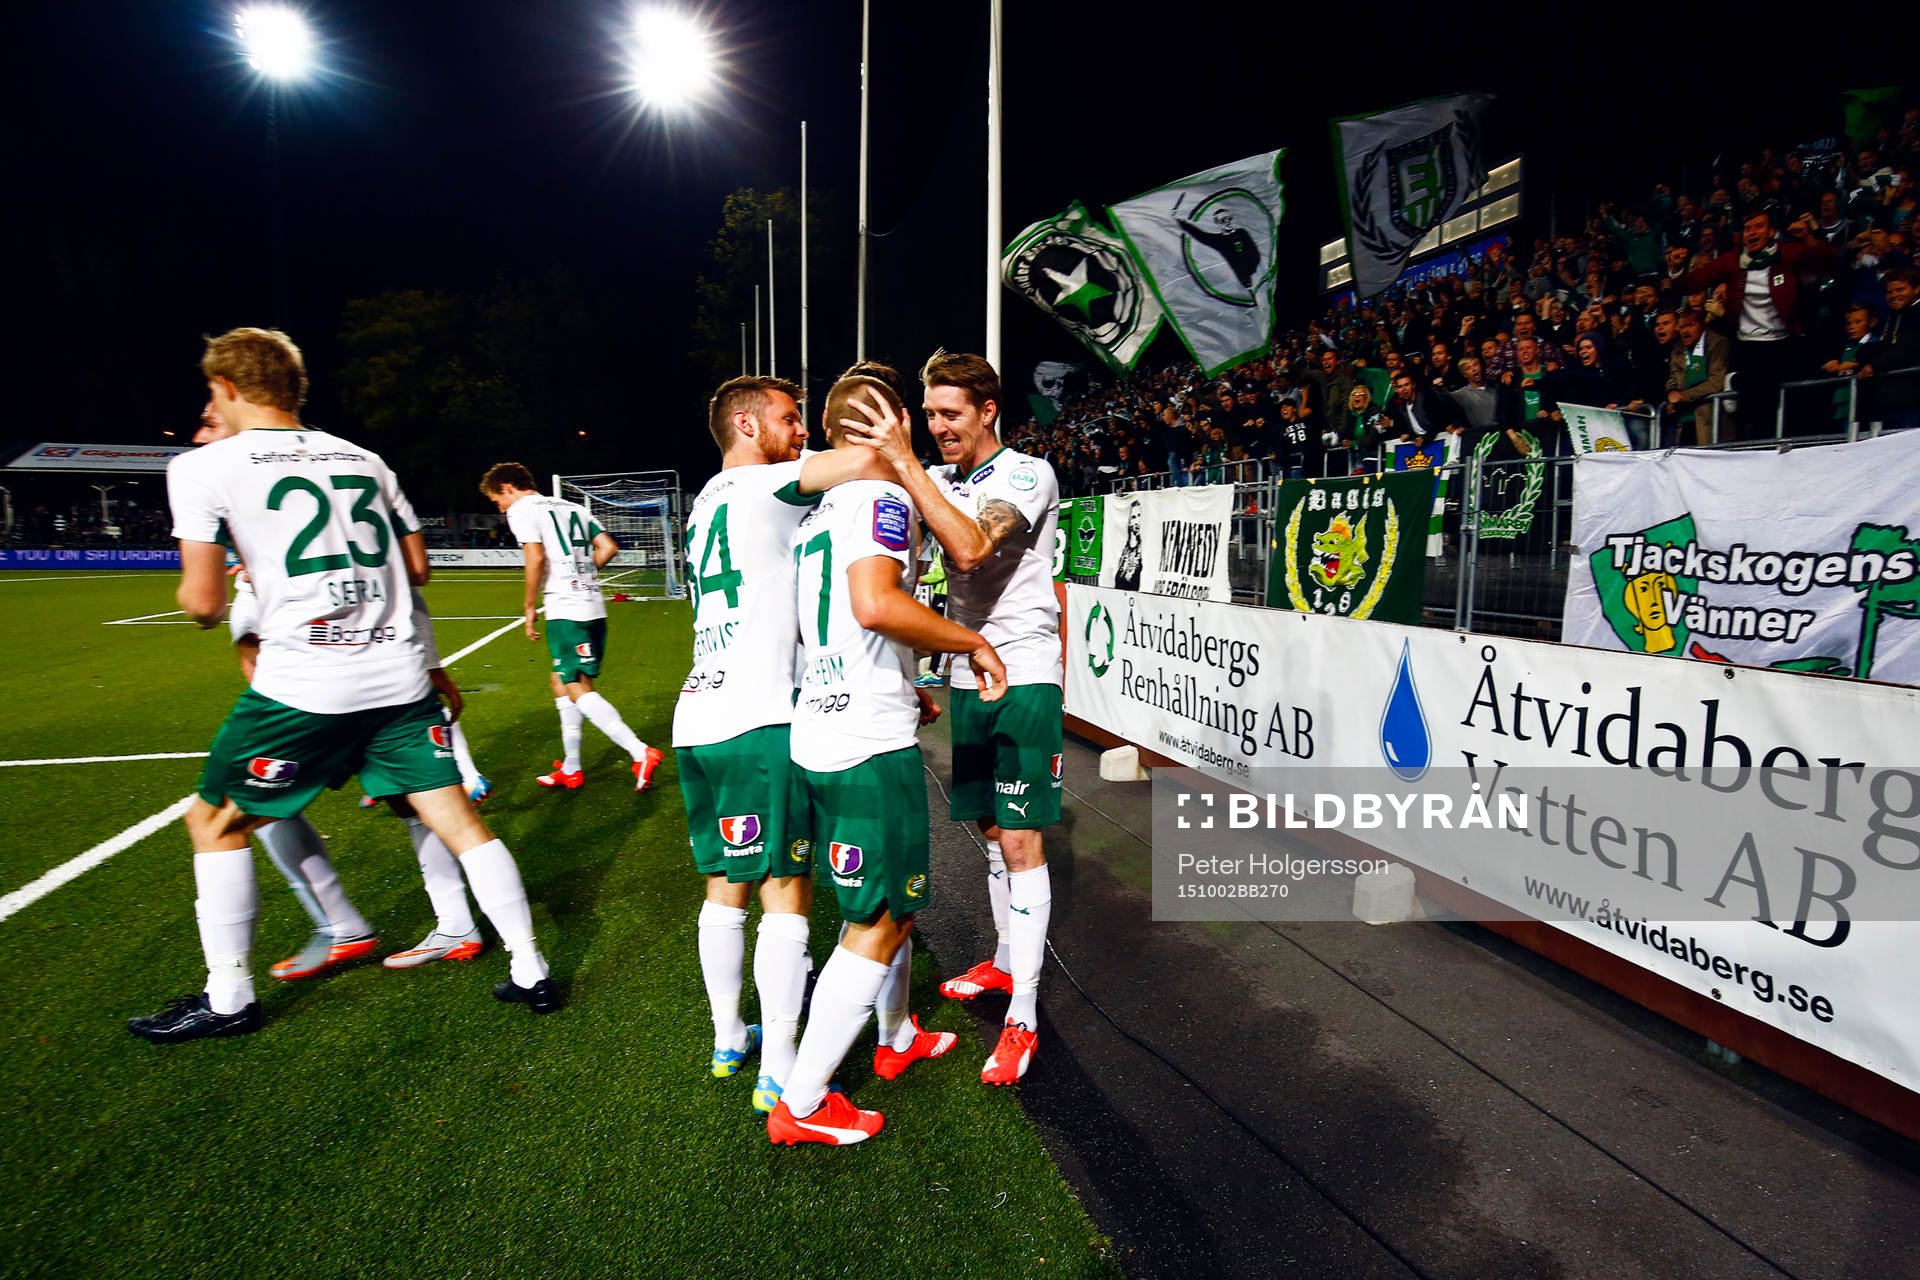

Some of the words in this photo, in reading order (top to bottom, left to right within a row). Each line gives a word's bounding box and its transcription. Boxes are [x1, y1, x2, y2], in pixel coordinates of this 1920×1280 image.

[267, 475, 389, 577] 23
[1308, 487, 1386, 511] Bagis
[16, 550, 50, 561] YOU
[55, 550, 80, 561] ON
[549, 511, 592, 556] 14
[1159, 519, 1222, 578] KENNEDY
[1607, 535, 1914, 594] Tjackskogens
[1123, 597, 1259, 688] Åtvidabergs
[1661, 590, 1814, 641] Vänner
[1121, 658, 1258, 756] Renhållning
[1264, 701, 1314, 760] AB
[1158, 729, 1250, 778] www.åtvidaberg.se
[1460, 645, 1920, 871] Åtvidaberg
[995, 780, 1030, 795] nair
[1461, 751, 1684, 893] Vatten
[1704, 832, 1857, 948] AB
[1524, 875, 1834, 1023] www.åtvidaberg.se
